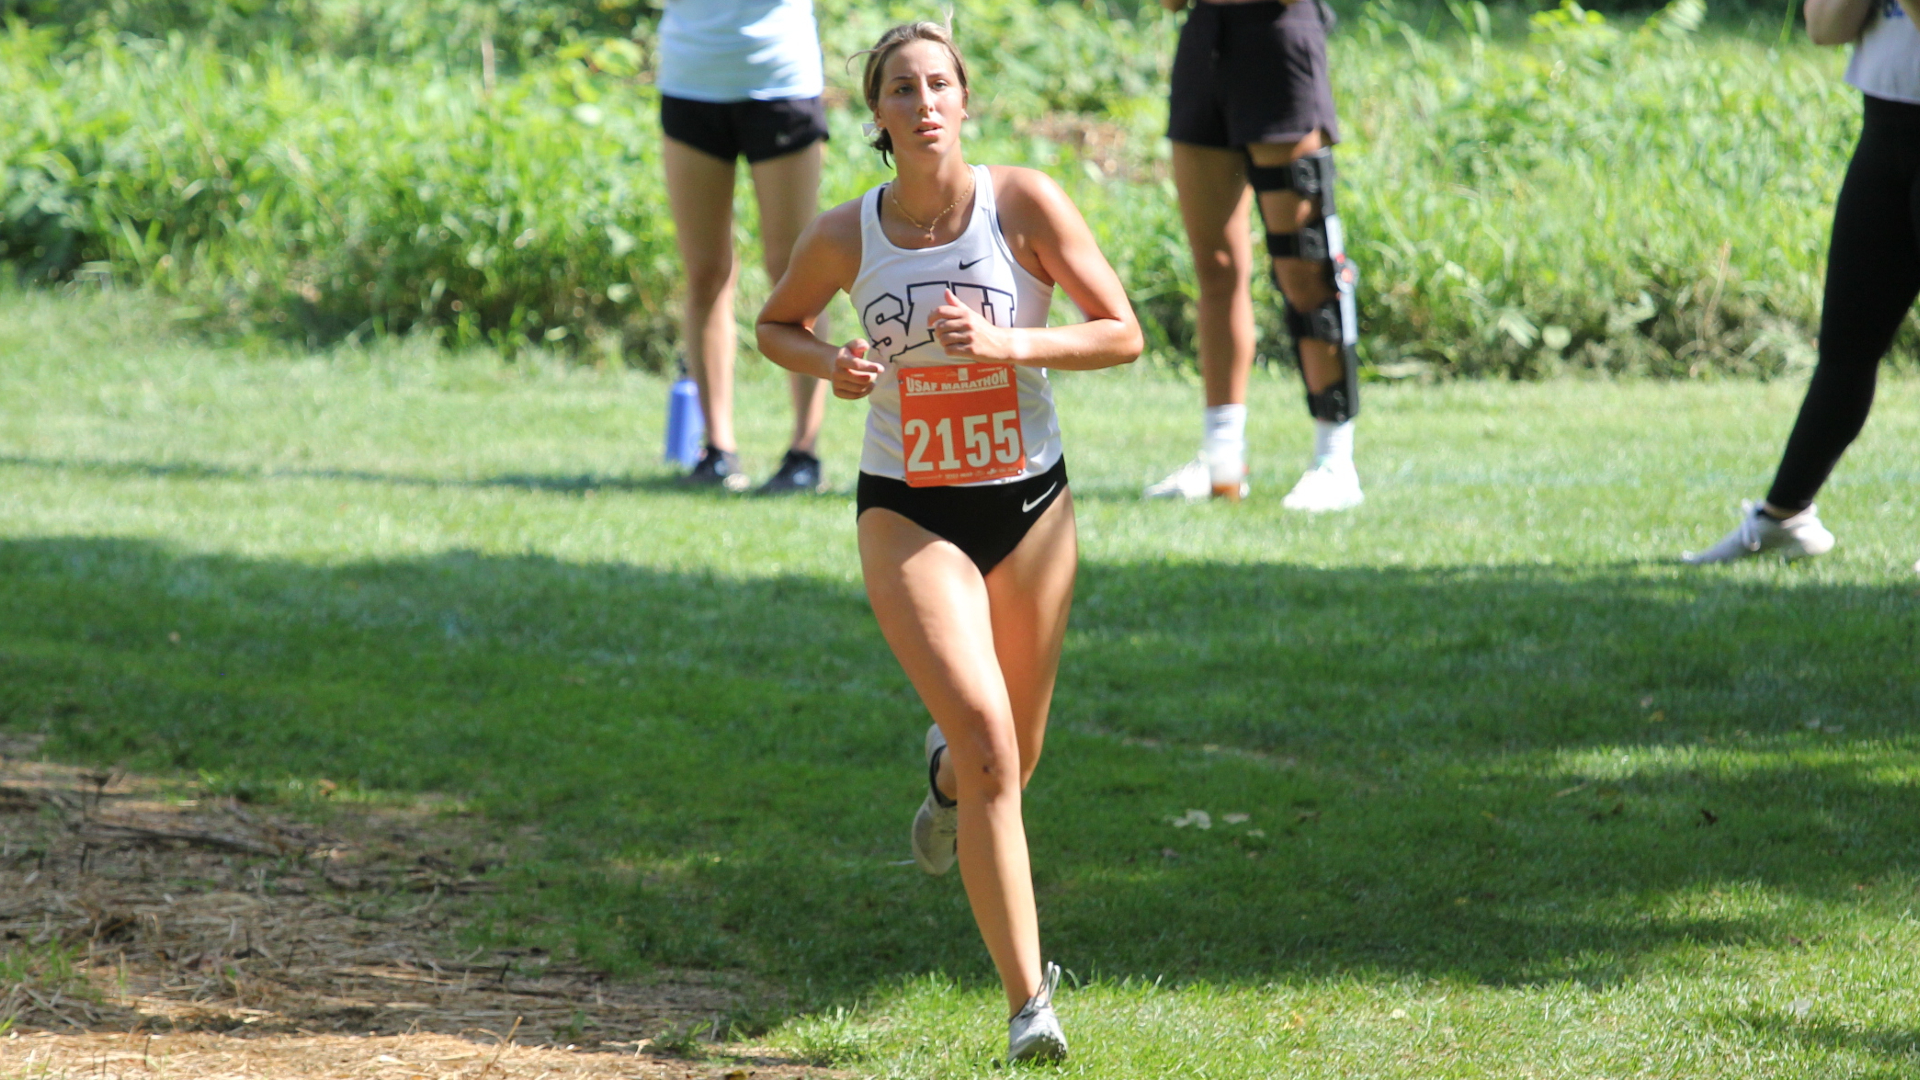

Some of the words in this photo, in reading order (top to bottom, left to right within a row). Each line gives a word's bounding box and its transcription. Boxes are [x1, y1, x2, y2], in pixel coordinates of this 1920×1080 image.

[905, 376, 938, 393] USAF
[941, 368, 1009, 391] MARATHON
[904, 409, 1021, 472] 2155
